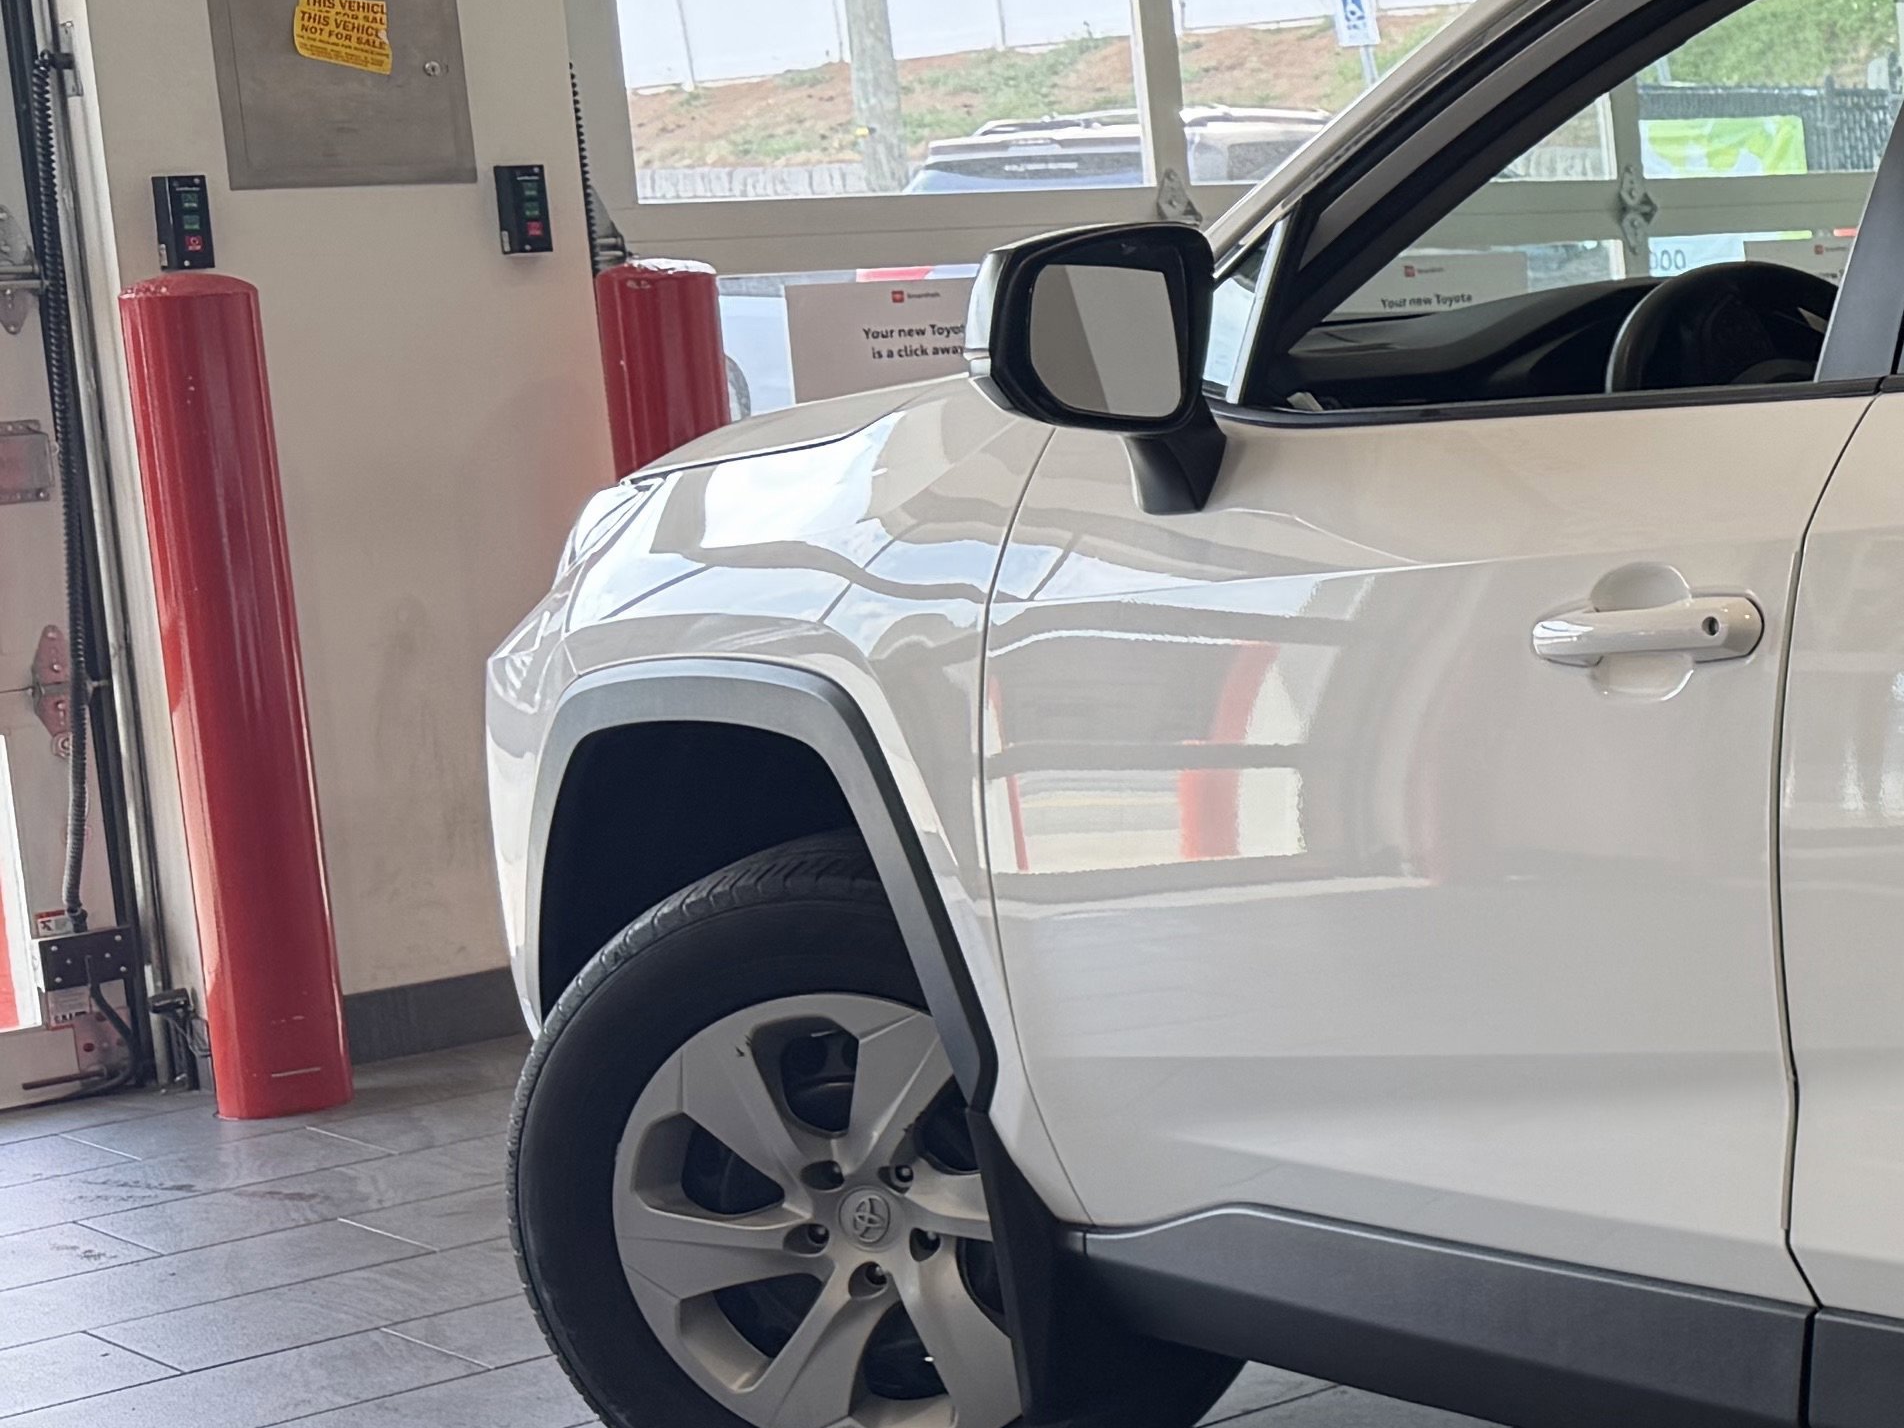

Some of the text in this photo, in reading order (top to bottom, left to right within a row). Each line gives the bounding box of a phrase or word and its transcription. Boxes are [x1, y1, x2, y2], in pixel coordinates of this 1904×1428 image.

[300, 10, 330, 27] THIS
[301, 24, 324, 36] NOT
[328, 29, 353, 43] FOR
[863, 328, 894, 340] Your
[898, 328, 926, 338] new
[872, 347, 883, 359] is
[886, 349, 894, 358] a
[897, 345, 929, 358] click
